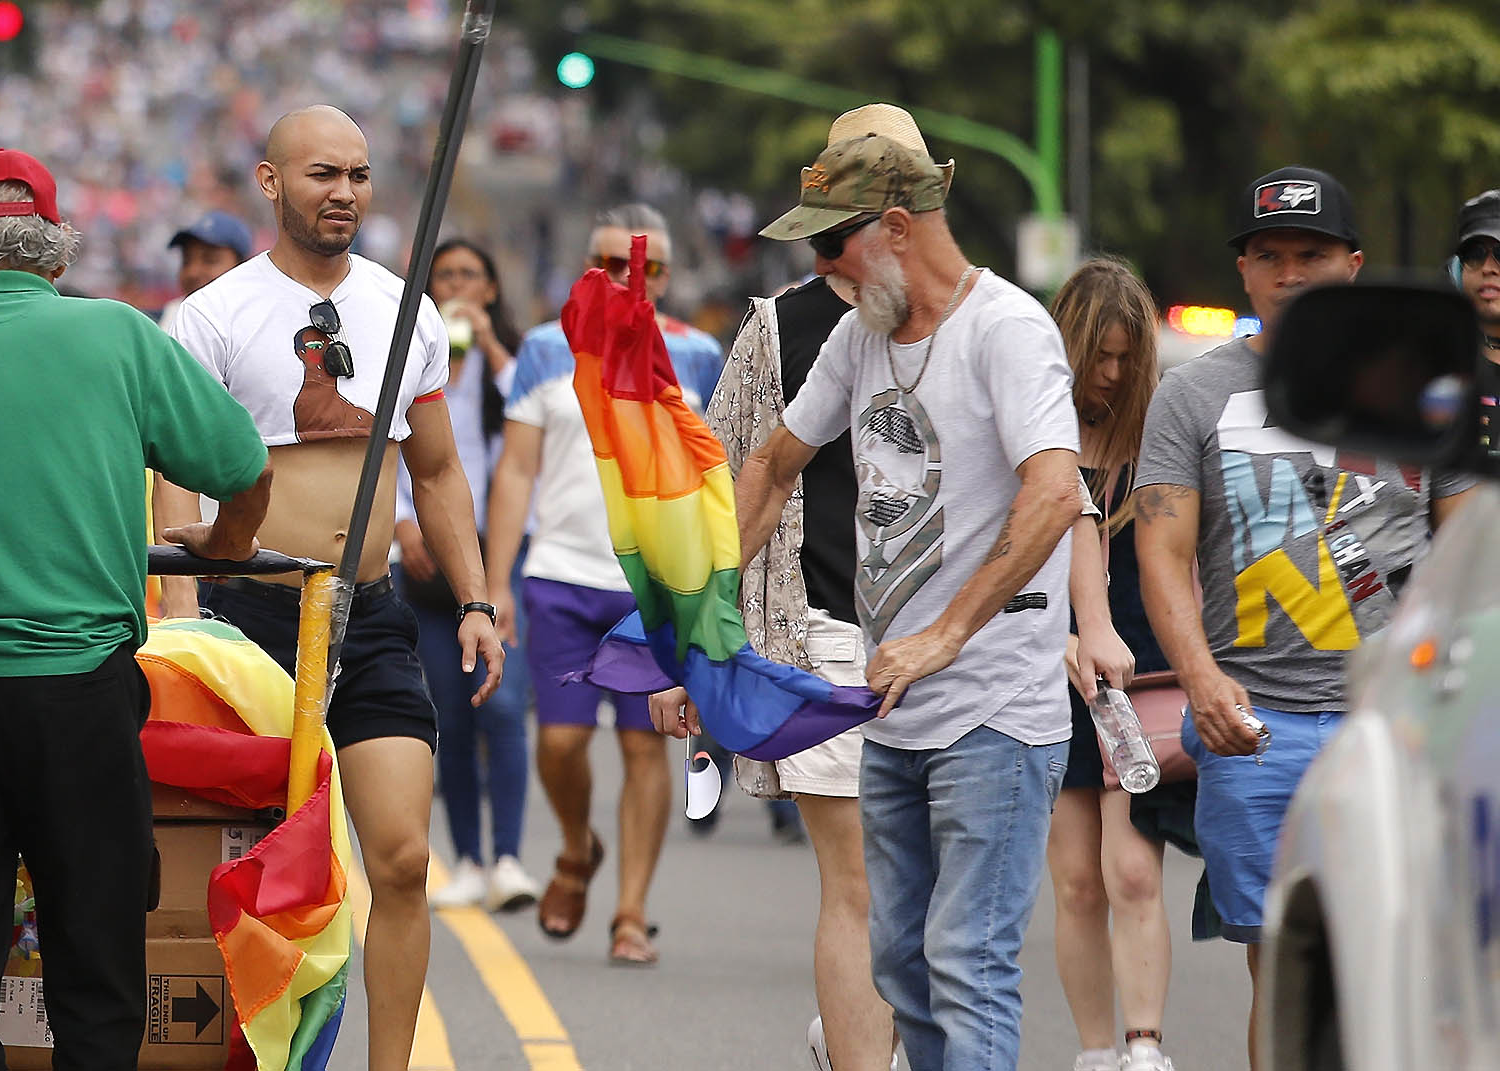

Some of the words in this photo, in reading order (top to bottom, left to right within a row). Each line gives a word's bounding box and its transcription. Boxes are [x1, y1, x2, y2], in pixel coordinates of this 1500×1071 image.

[163, 978, 171, 1002] THIS
[151, 977, 161, 1042] FRAGILE
[162, 1027, 170, 1041] UP
